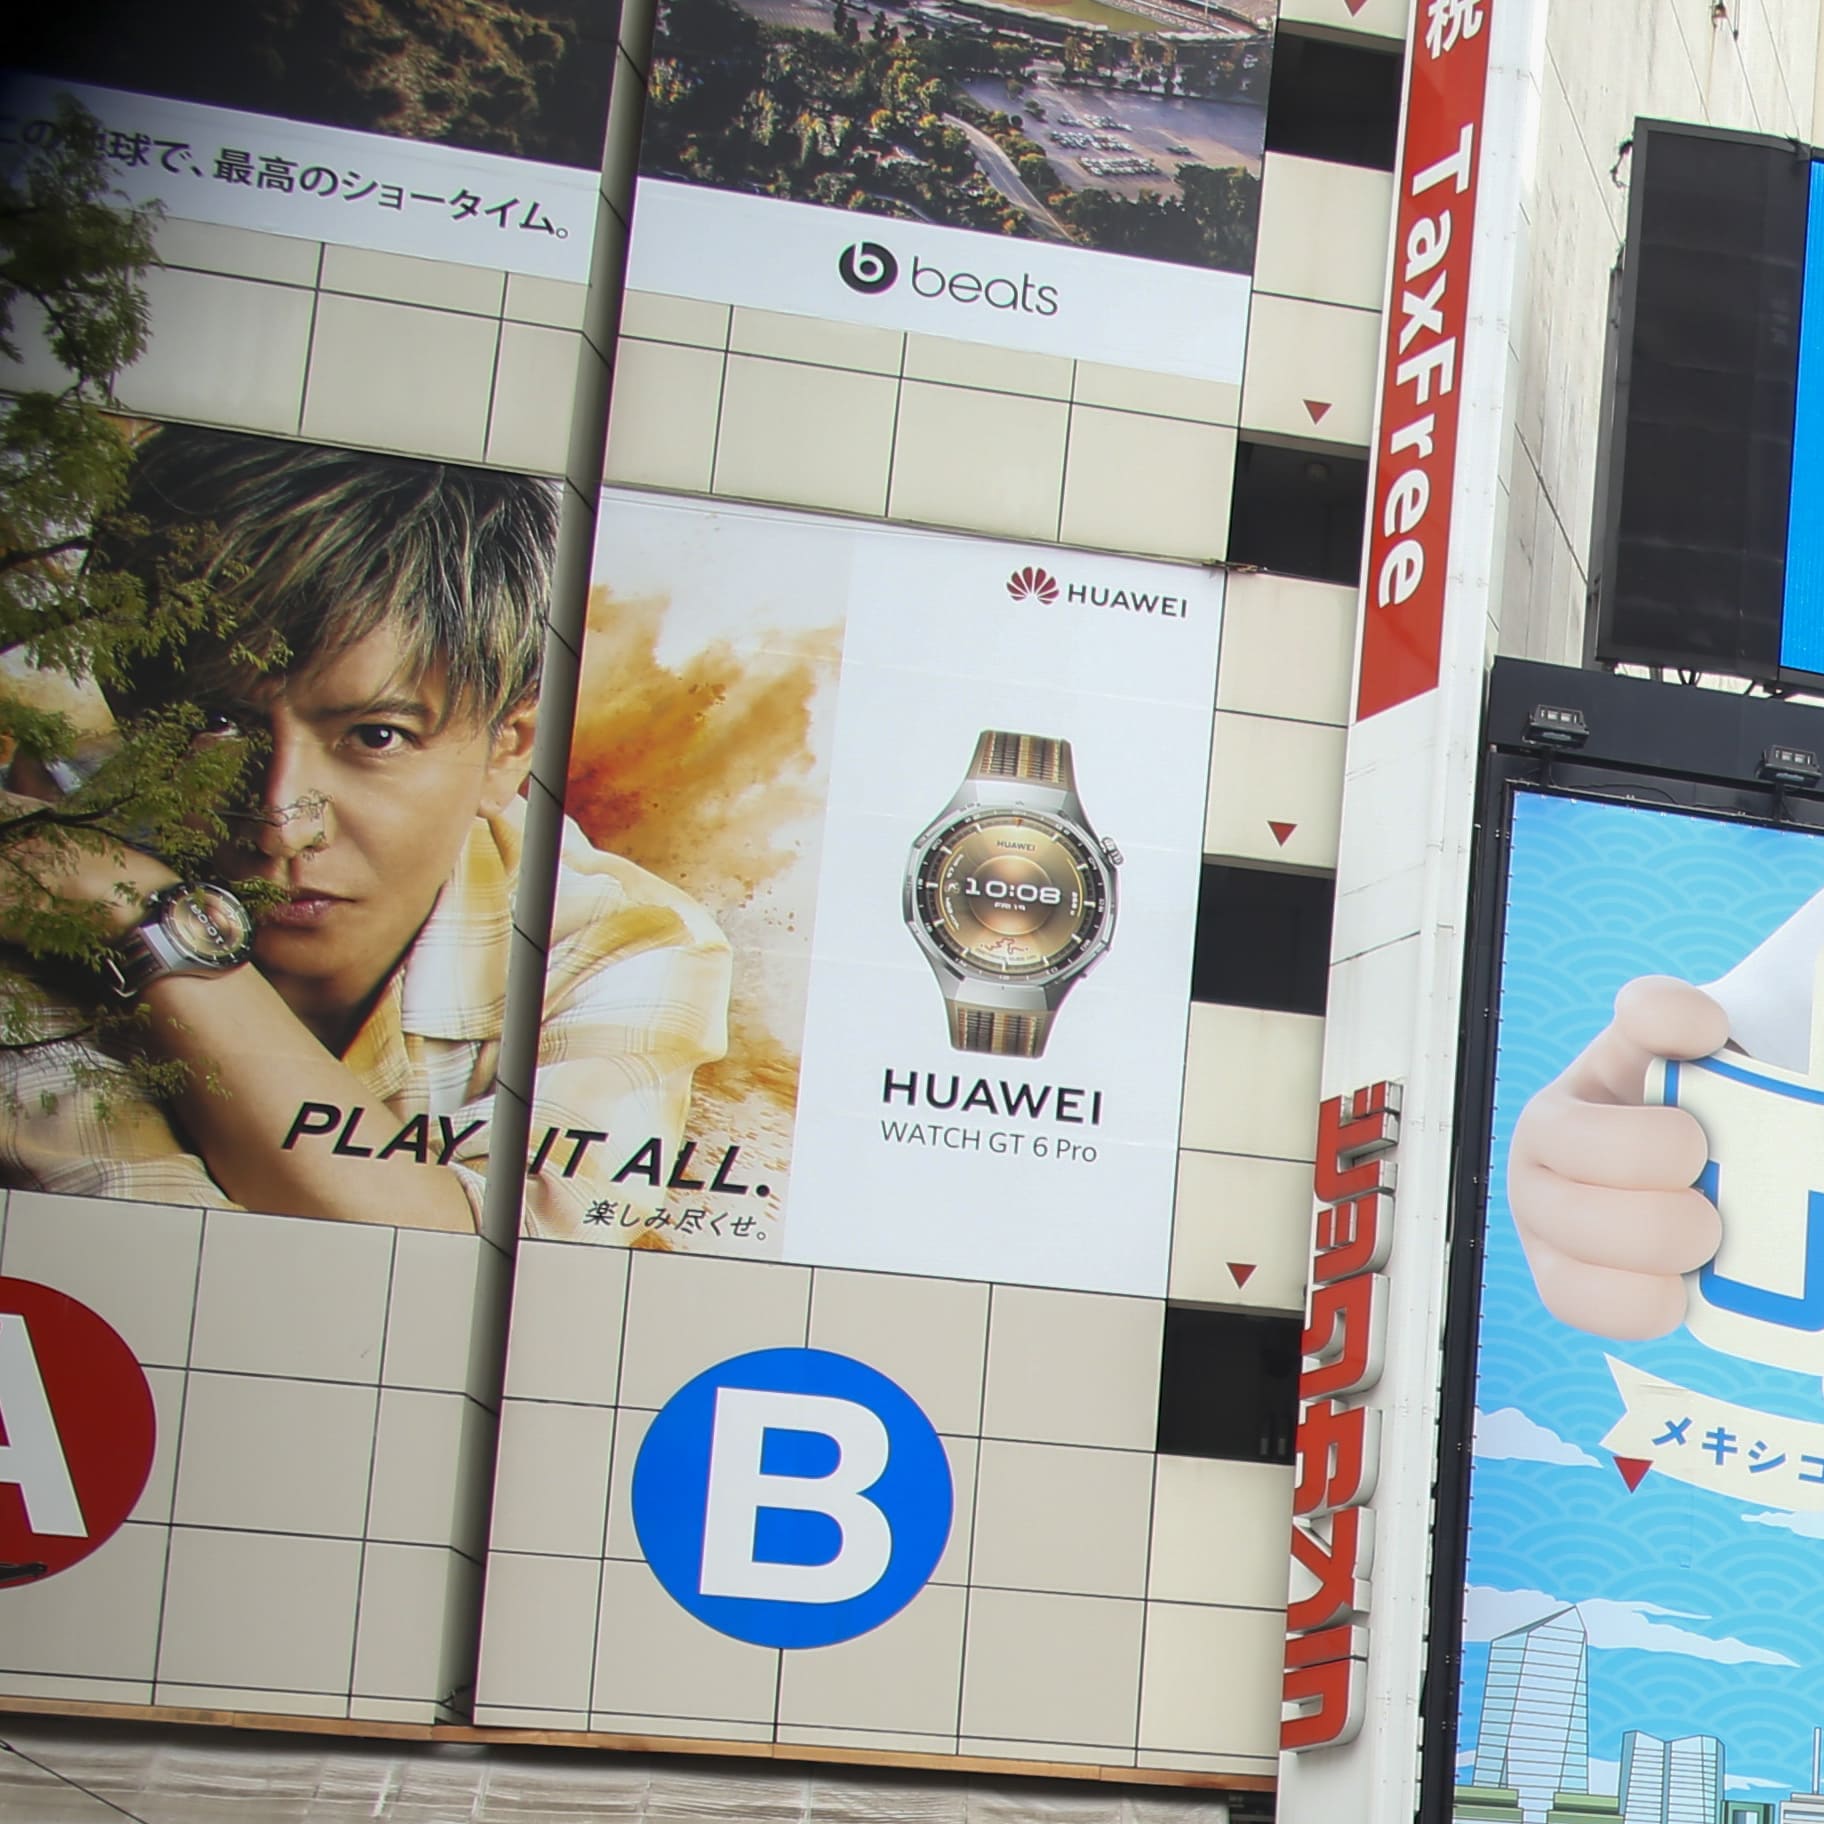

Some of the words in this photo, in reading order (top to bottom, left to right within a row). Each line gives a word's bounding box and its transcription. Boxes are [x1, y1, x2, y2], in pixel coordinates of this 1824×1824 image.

[911, 256, 1060, 317] beats
[1378, 123, 1475, 608] TaxFree
[1067, 581, 1189, 620] HUAWEI
[964, 877, 1062, 905] 10:08
[882, 1068, 1103, 1127] HUAWEI
[281, 1101, 488, 1168] PLAY
[528, 1126, 608, 1178] IT
[613, 1136, 774, 1199] ALL.
[880, 1118, 981, 1153] WATCH
[989, 1128, 1027, 1158] GT
[1031, 1133, 1051, 1159] 6
[1056, 1134, 1099, 1164] Pro
[583, 1199, 769, 1243] 楽しみ尽くせ。
[698, 1386, 894, 1606] B
